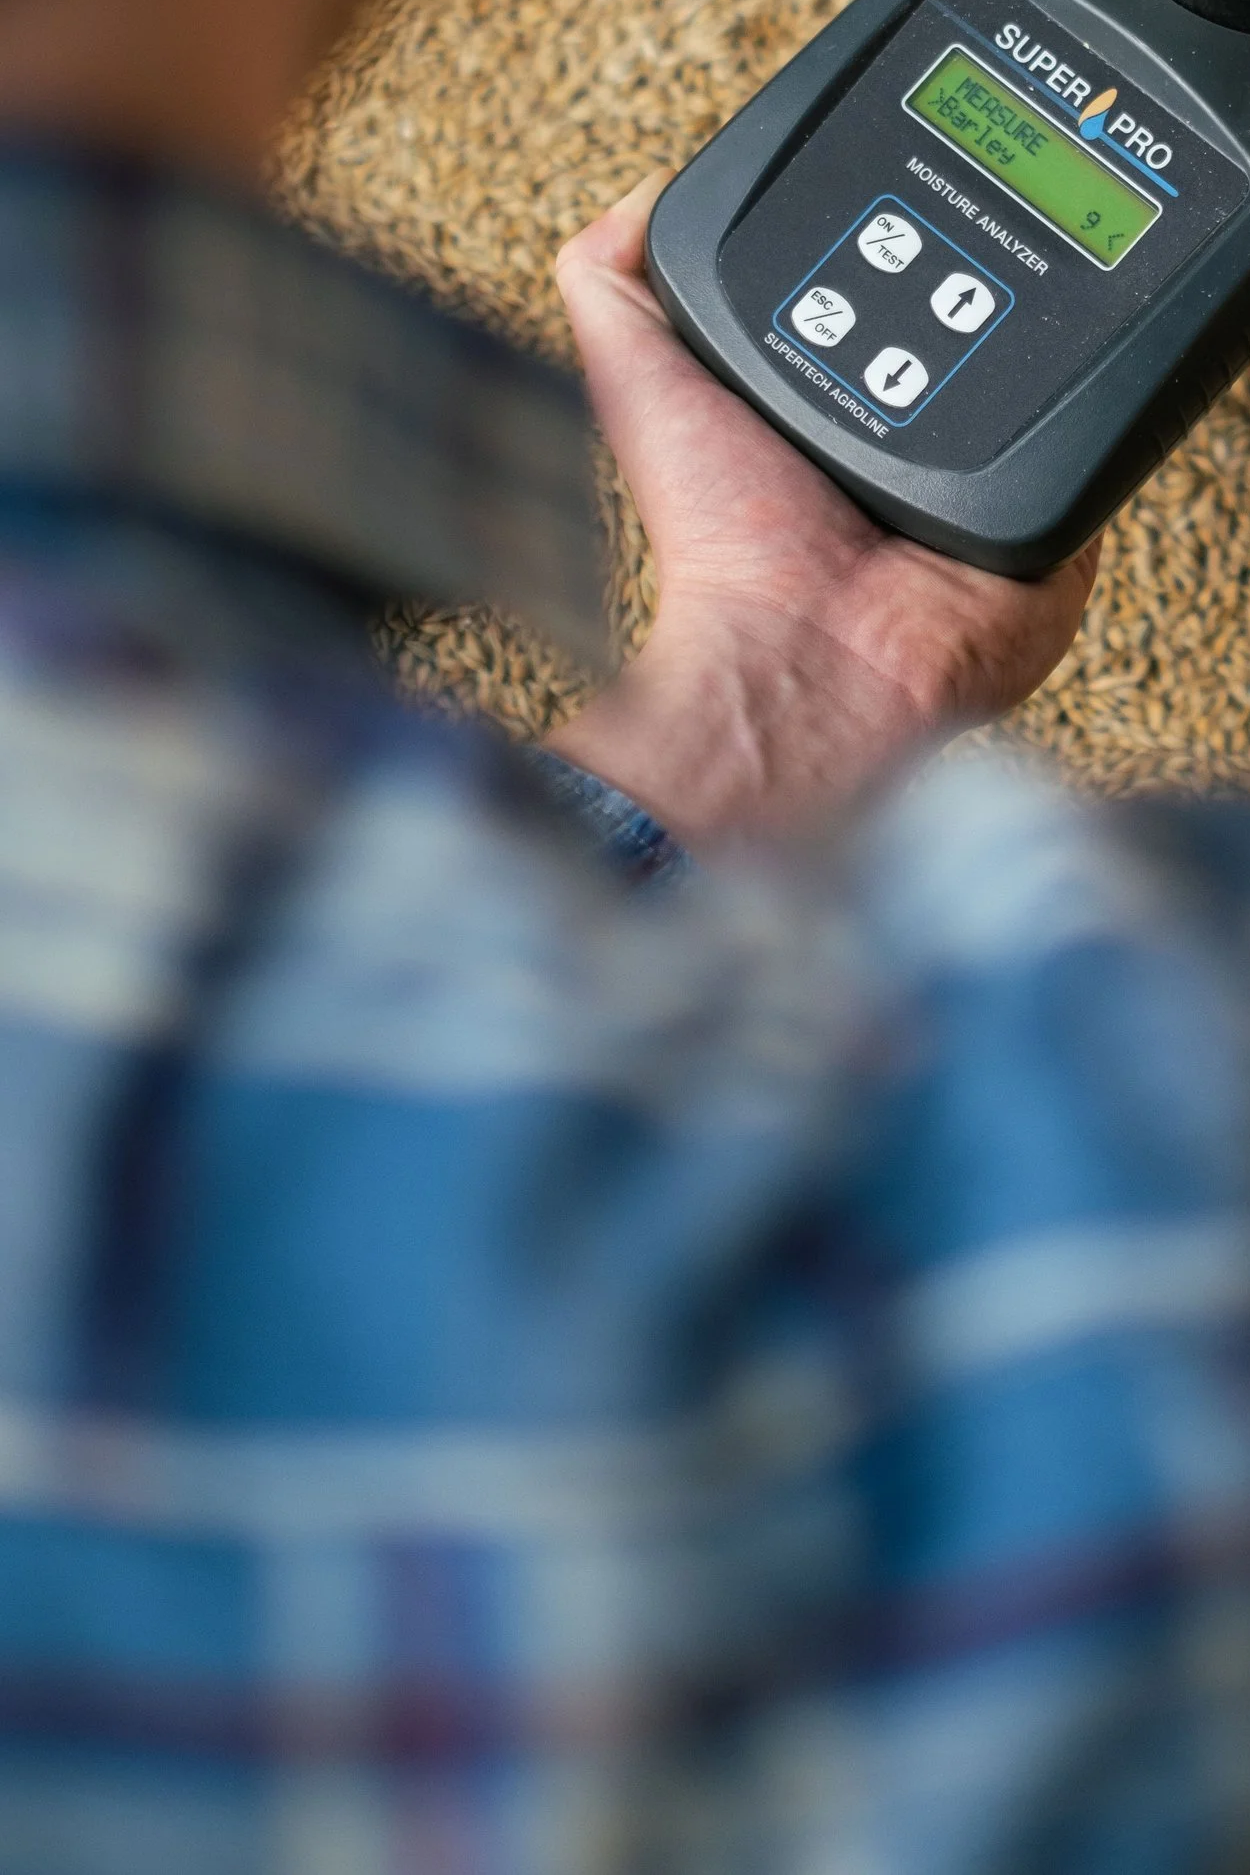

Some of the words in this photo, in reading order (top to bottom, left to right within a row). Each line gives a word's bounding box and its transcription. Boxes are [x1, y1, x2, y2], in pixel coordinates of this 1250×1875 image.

[995, 24, 1091, 107] SUPER
[1107, 113, 1172, 170] PRO
[955, 77, 1049, 156] MEASURE
[876, 216, 895, 233] ON
[906, 157, 980, 220] MOISTURE
[976, 216, 1049, 276] ANALYZER
[1080, 210, 1101, 231] 9
[877, 244, 905, 269] TEST
[810, 290, 834, 311] ESC
[814, 323, 837, 341] OFF
[764, 332, 832, 391] SUPERTECH
[829, 388, 889, 438] AGROLINE
